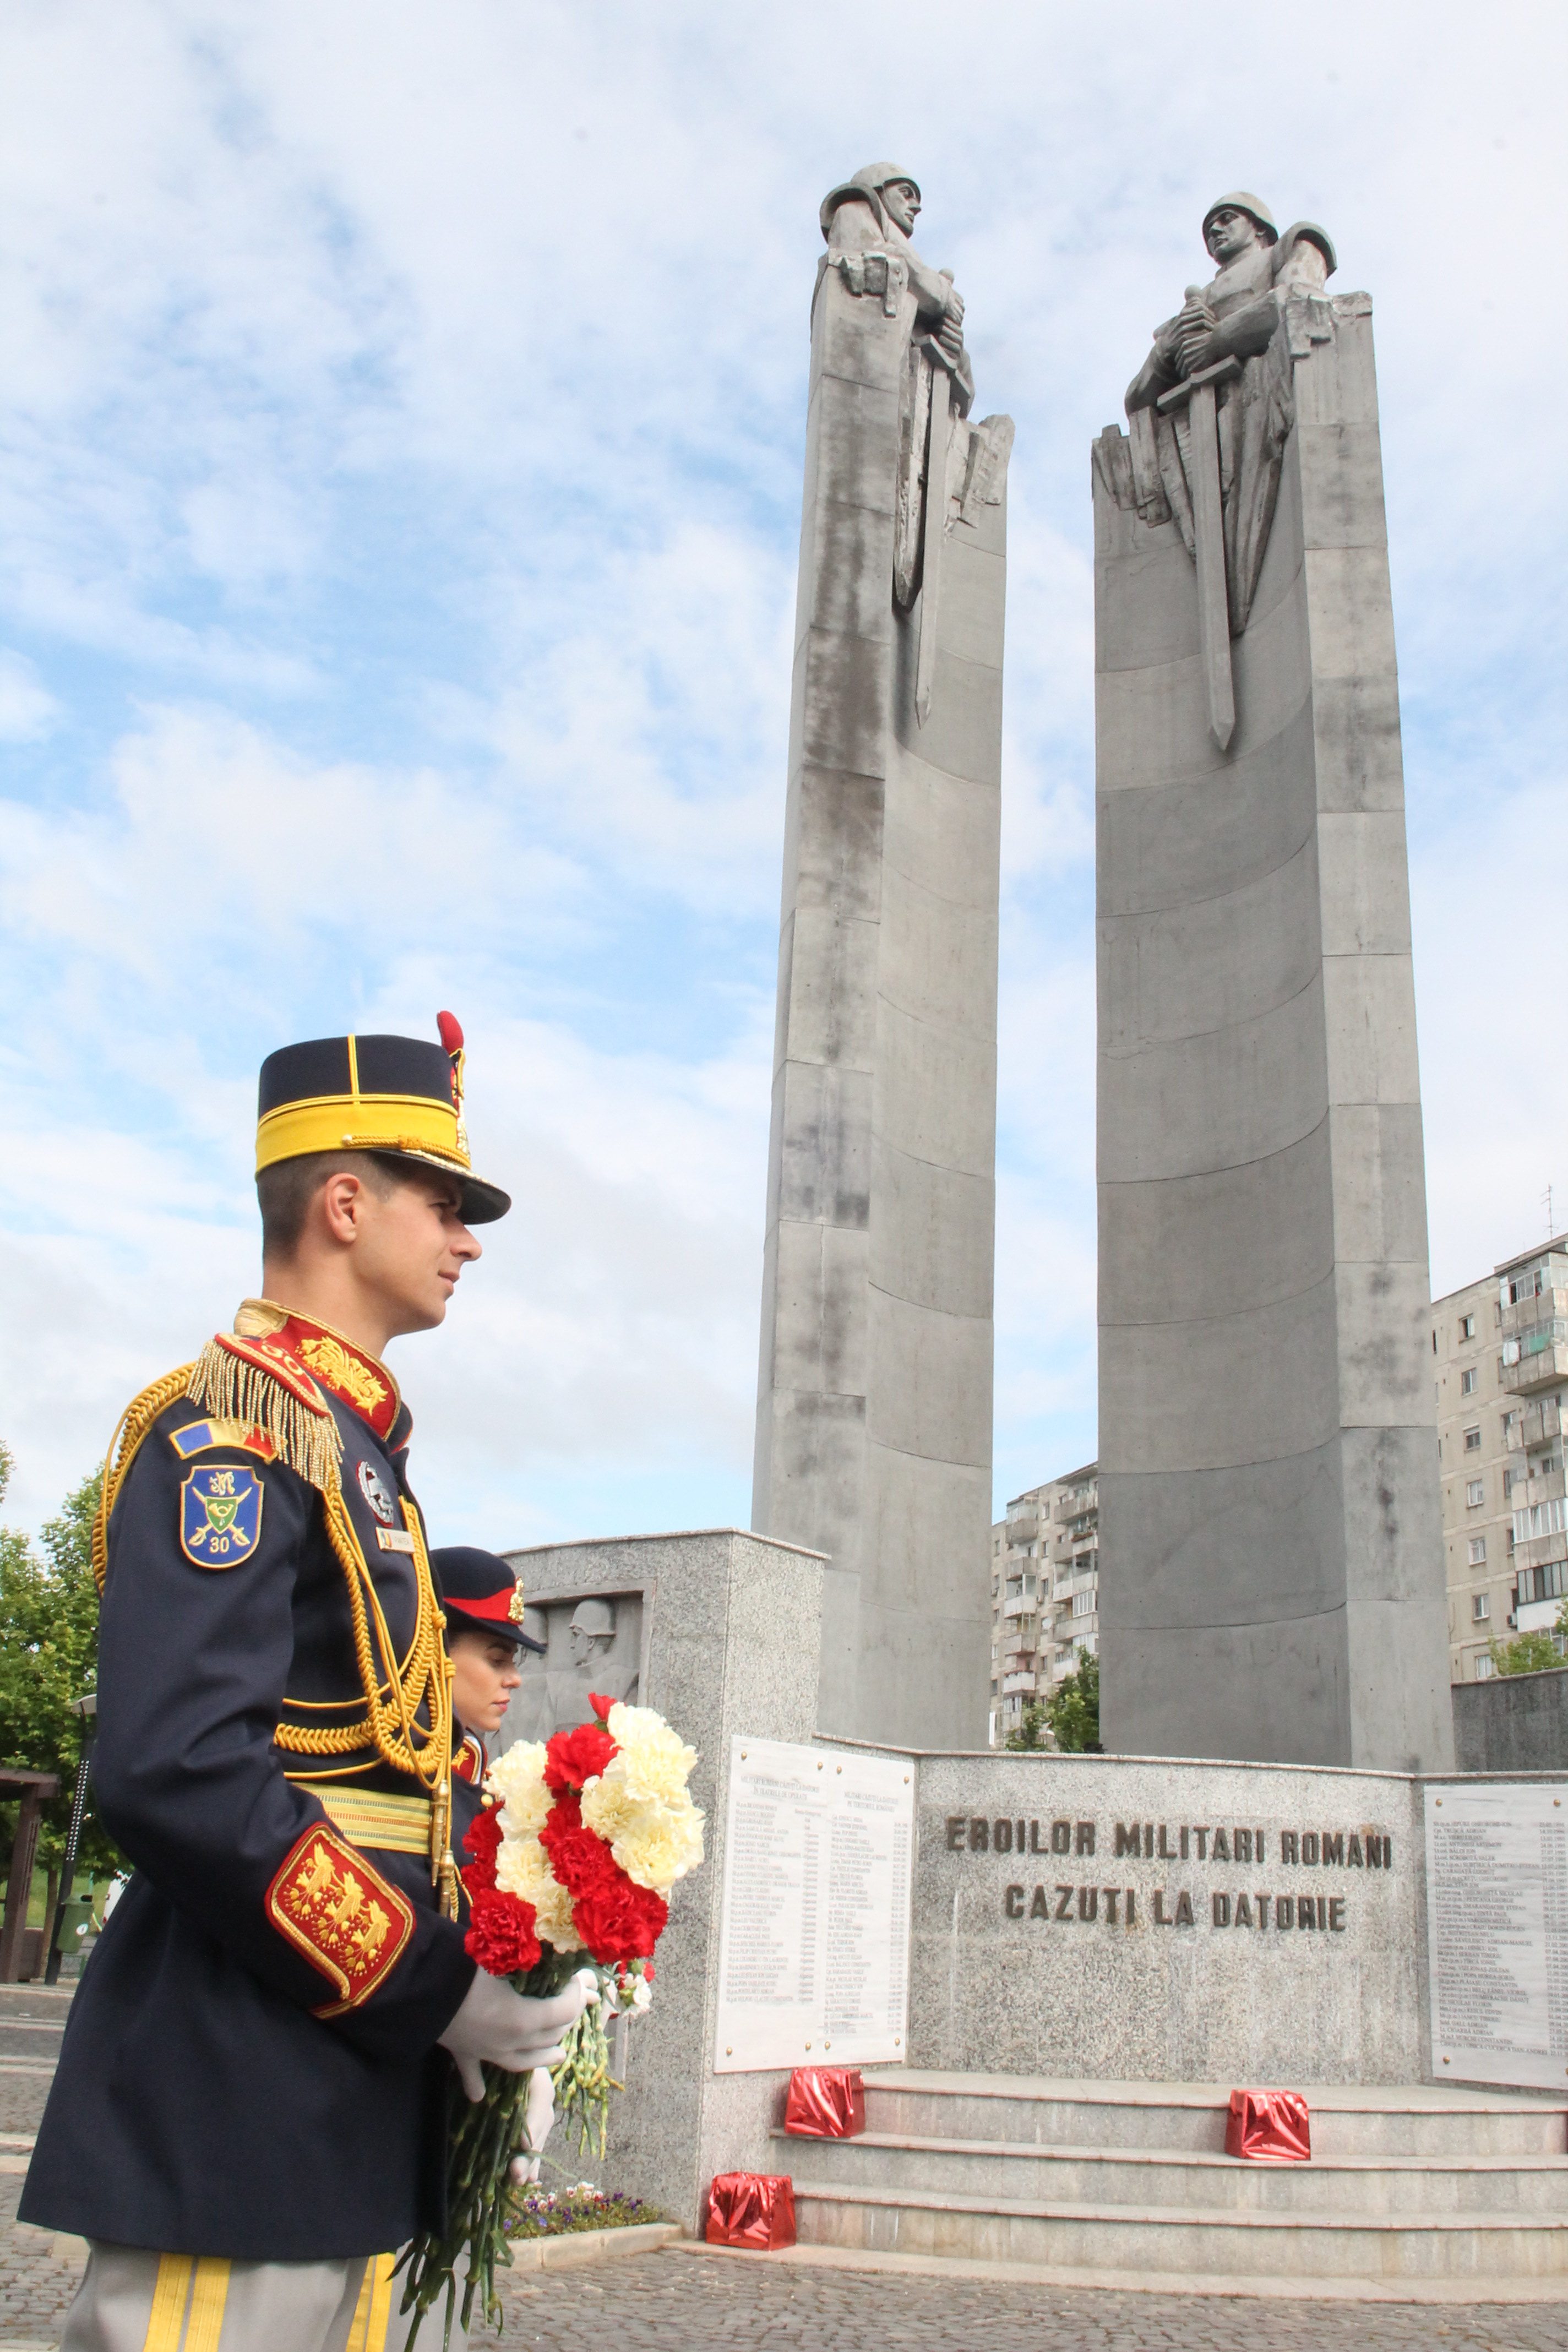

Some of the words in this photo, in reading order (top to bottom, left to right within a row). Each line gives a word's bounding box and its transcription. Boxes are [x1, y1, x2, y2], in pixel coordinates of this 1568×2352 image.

[210, 1537, 230, 1554] 30
[946, 1816, 1095, 1856] EROILOR
[1115, 1822, 1265, 1863] MILITARI
[1282, 1830, 1392, 1869] ROMANI
[1005, 1883, 1135, 1924] CAZUTI
[1154, 1888, 1194, 1925] LA
[1213, 1891, 1346, 1930] DATORIE
